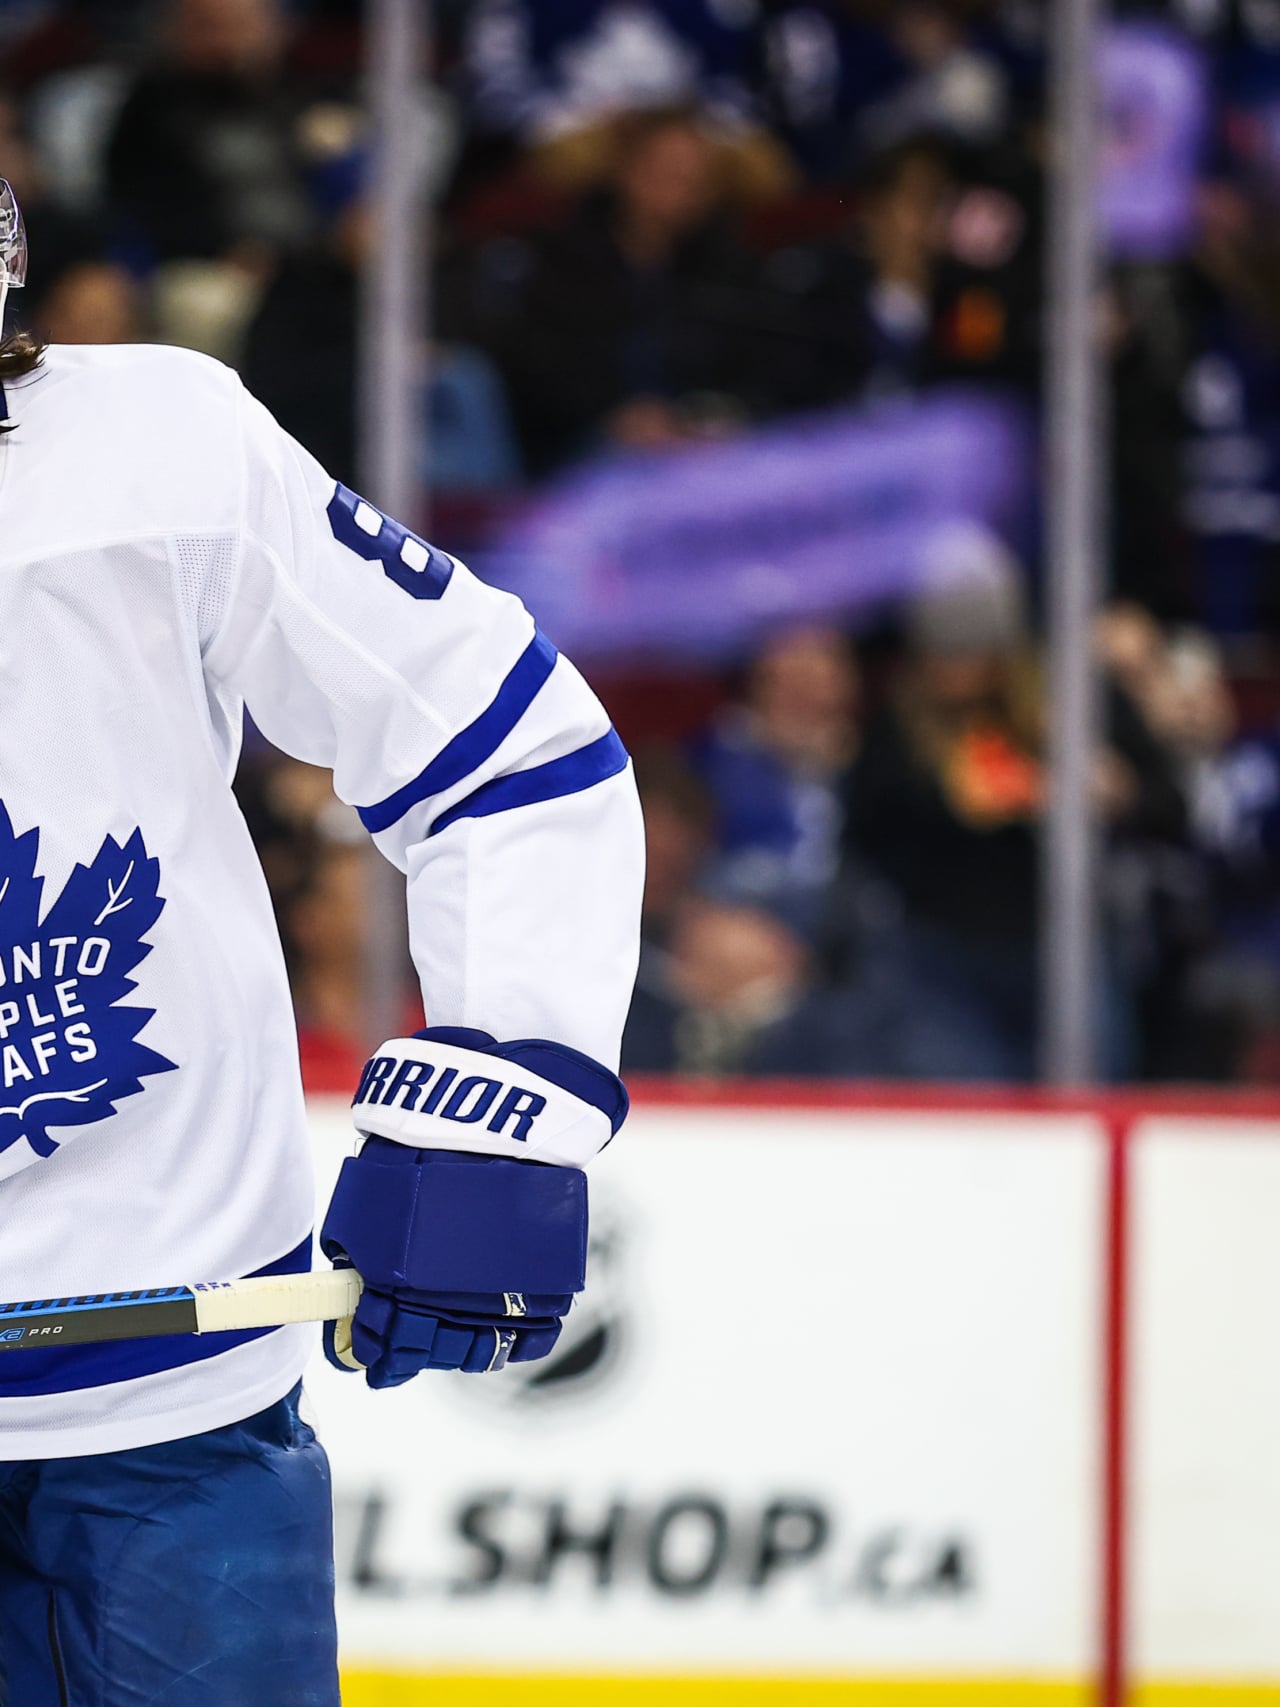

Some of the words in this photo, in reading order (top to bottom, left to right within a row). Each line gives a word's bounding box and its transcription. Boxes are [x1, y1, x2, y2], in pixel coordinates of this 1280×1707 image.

[326, 481, 455, 600] 8
[354, 1056, 548, 1142] RRIOR
[28, 1325, 64, 1337] PRO
[334, 1489, 975, 1604] LSHOP.CA
